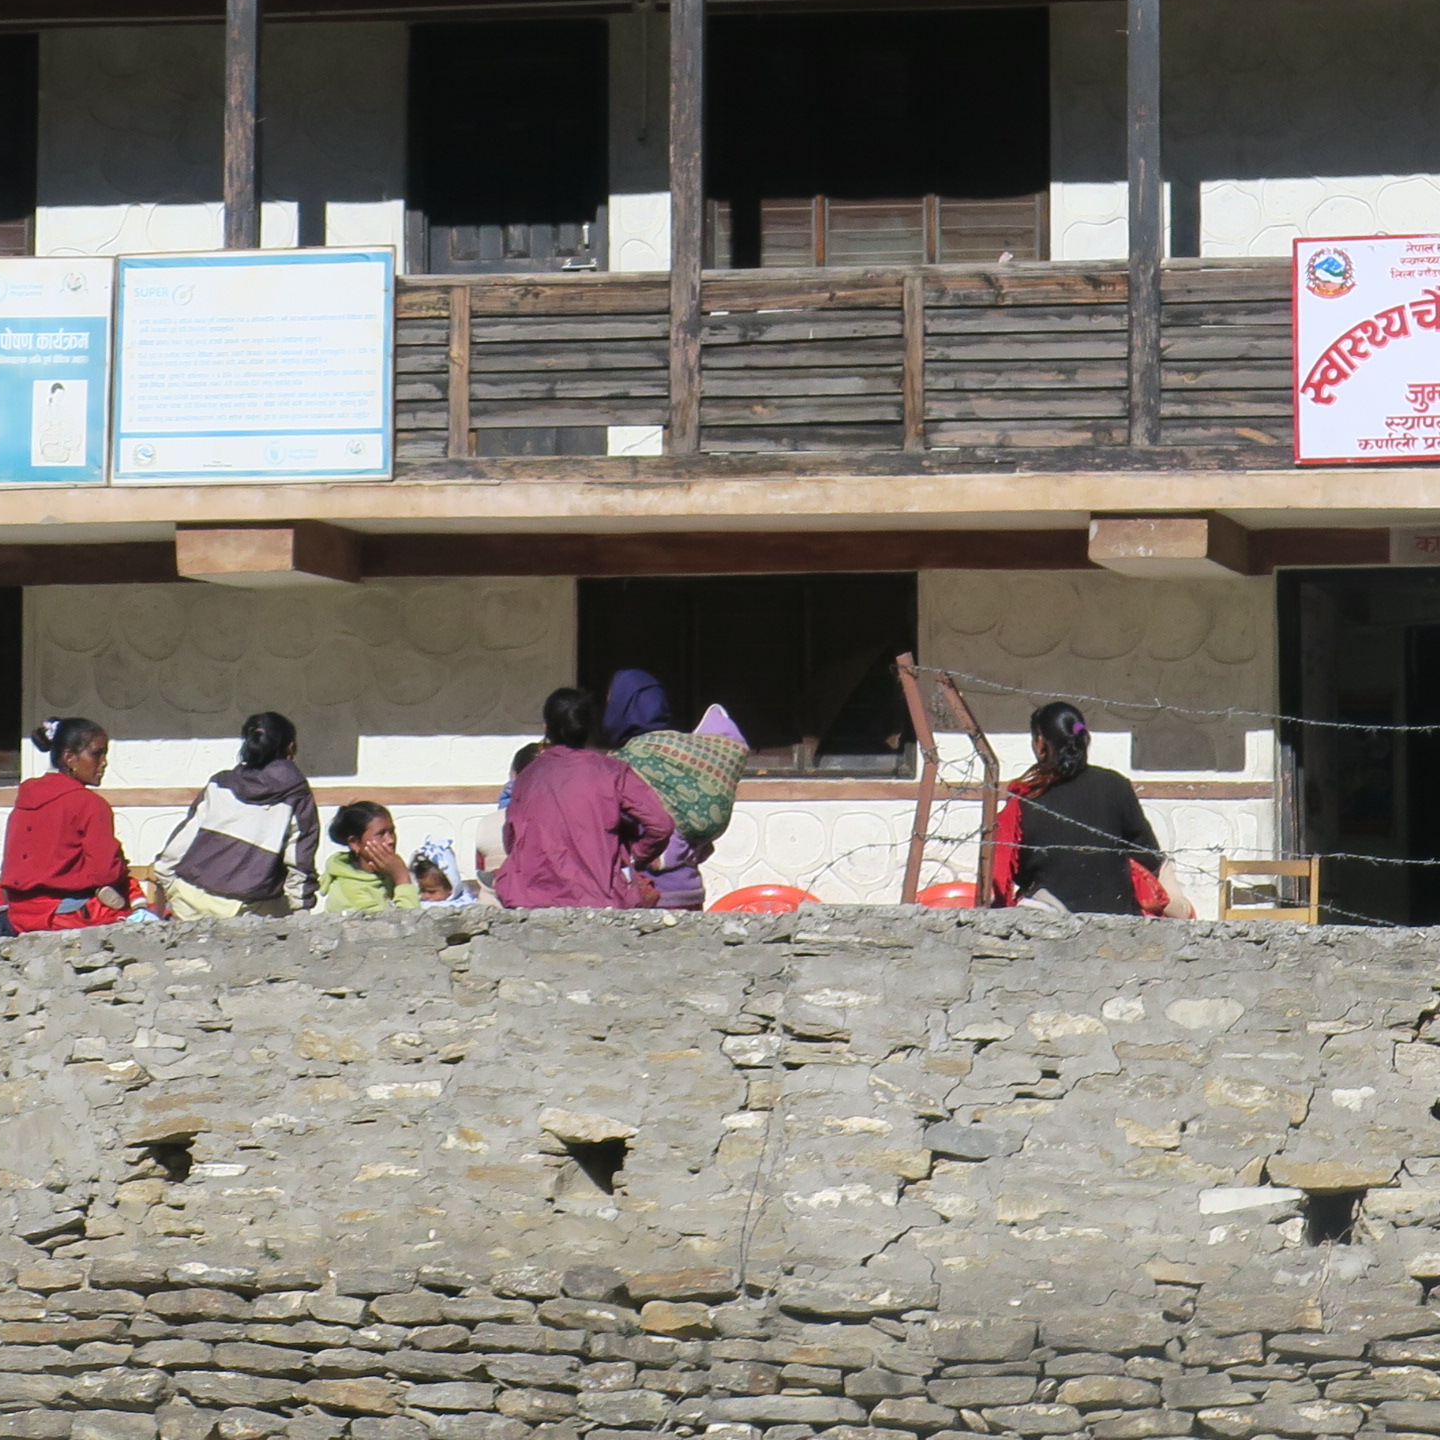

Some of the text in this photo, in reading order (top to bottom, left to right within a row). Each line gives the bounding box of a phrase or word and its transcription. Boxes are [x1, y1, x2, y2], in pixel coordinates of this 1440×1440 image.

[1406, 241, 1435, 253] नेपाल
[133, 287, 169, 297] SUPER
[0, 327, 34, 350] पोषण
[36, 327, 90, 351] कार्यक्रम
[1301, 305, 1412, 404] स्वास्थ्य
[1357, 433, 1418, 452] कर्णाली
